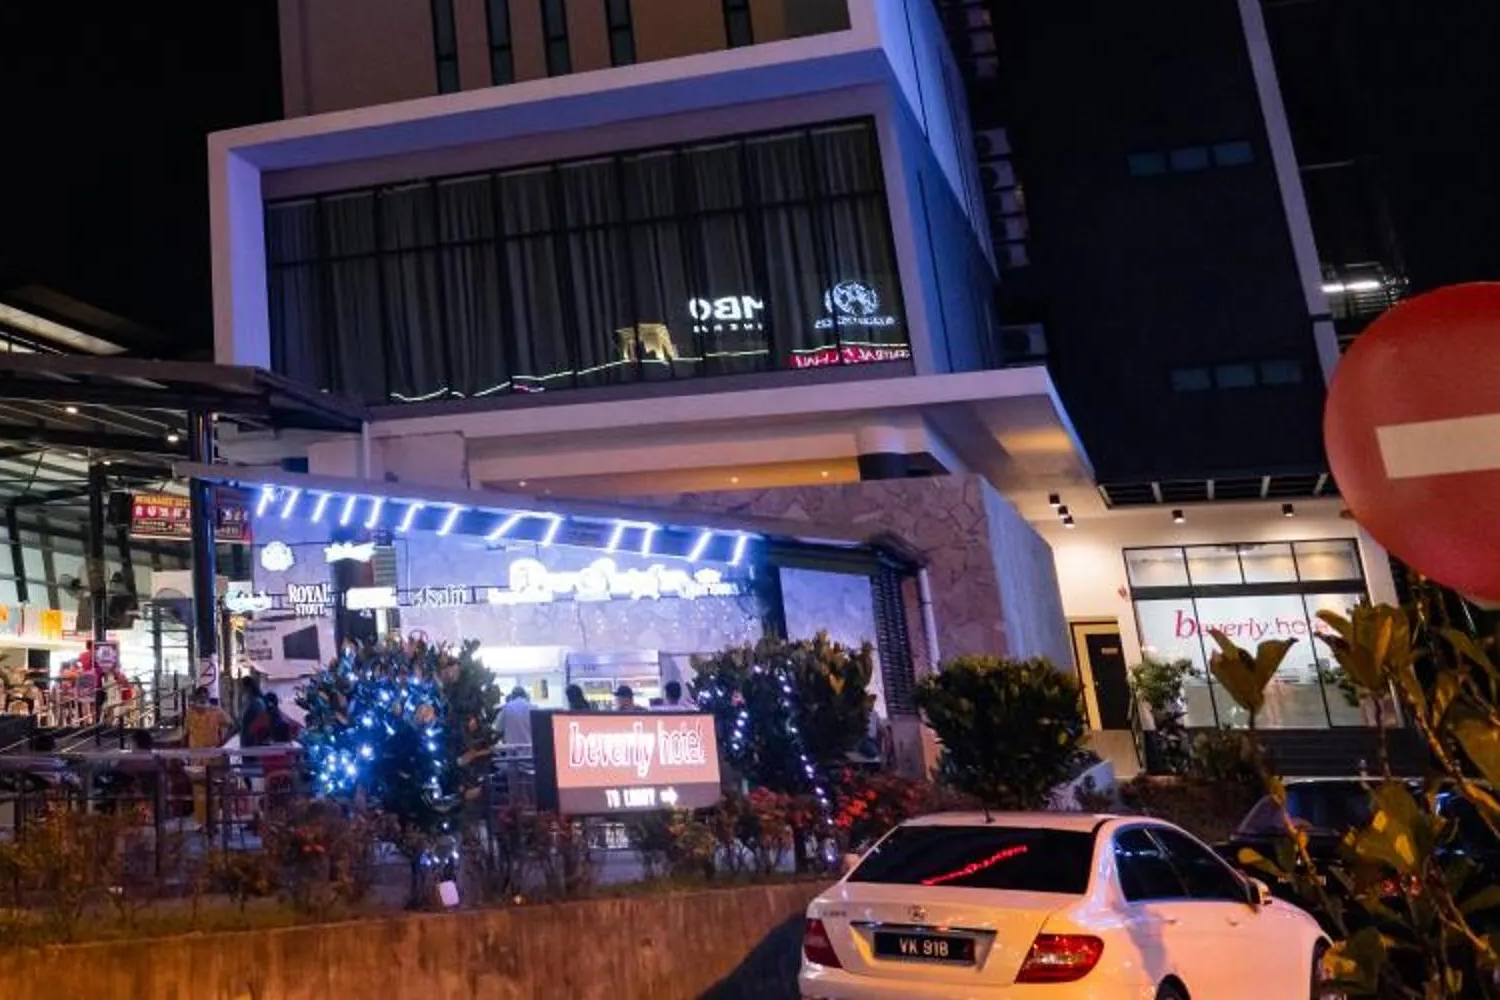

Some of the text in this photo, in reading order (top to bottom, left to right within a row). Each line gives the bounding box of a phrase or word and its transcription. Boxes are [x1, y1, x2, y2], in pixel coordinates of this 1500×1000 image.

[288, 583, 330, 603] ROYAL
[569, 719, 706, 777] beverly hotel
[899, 938, 918, 954] VK
